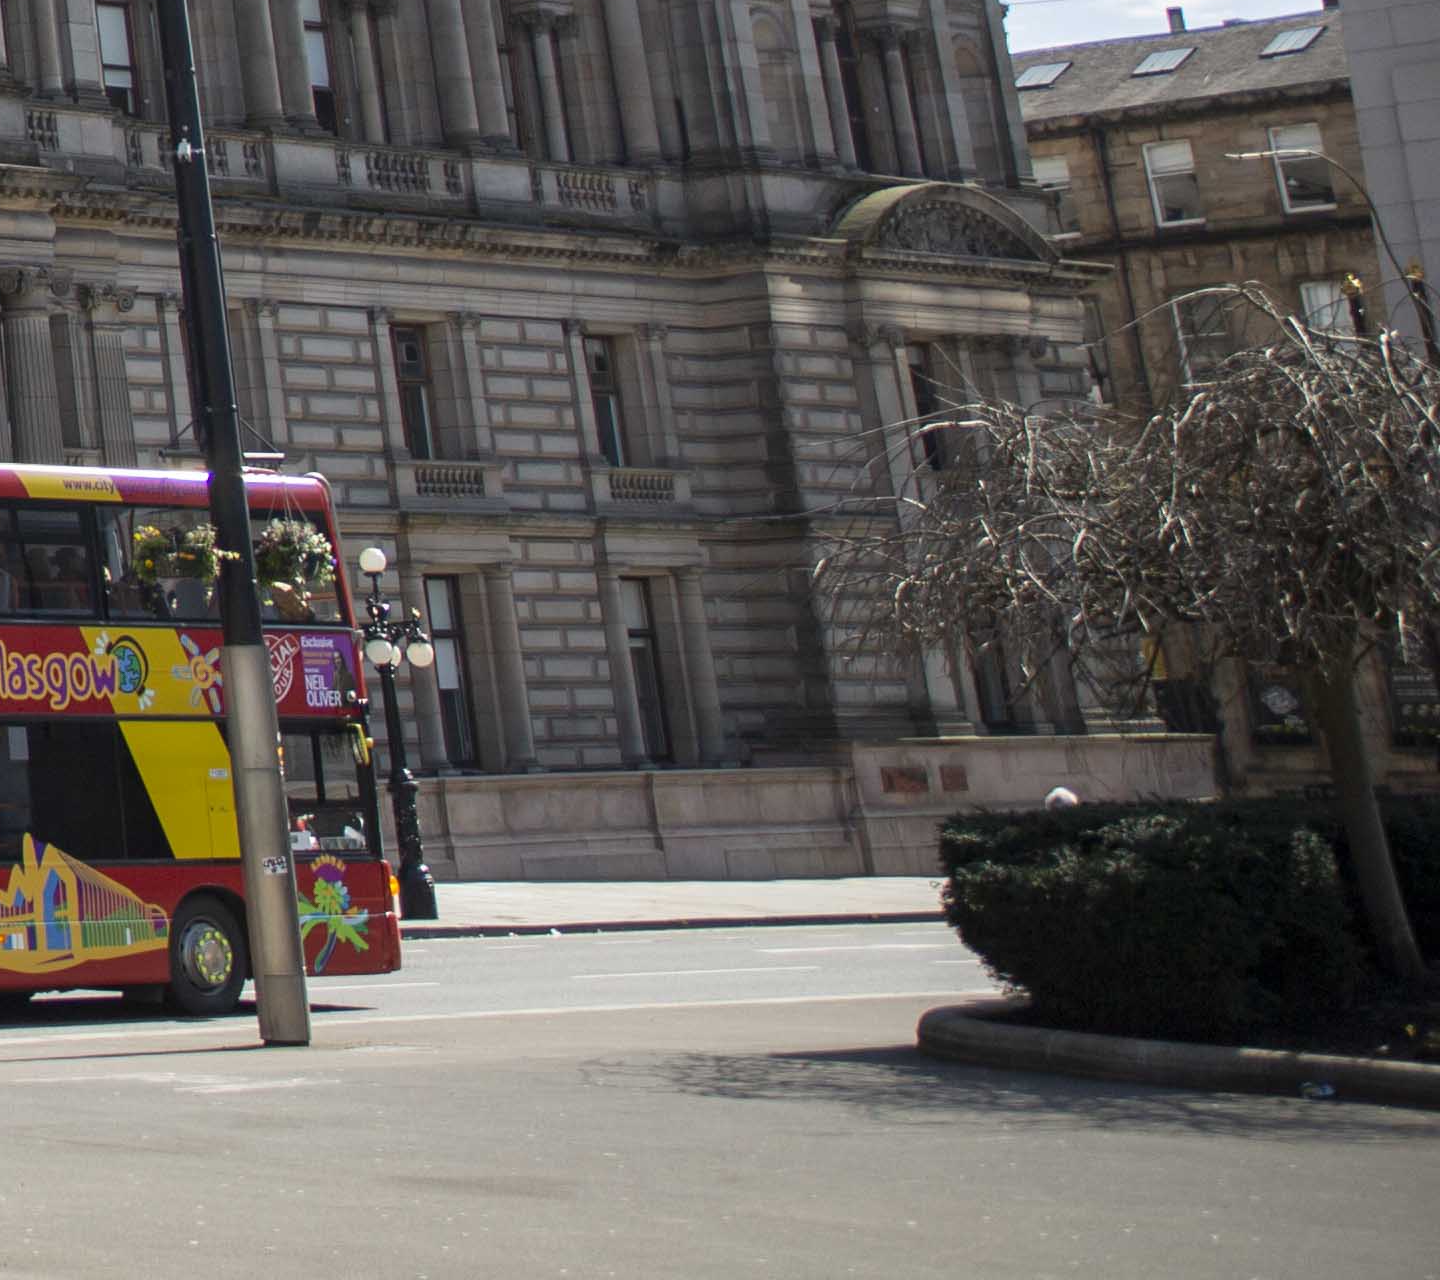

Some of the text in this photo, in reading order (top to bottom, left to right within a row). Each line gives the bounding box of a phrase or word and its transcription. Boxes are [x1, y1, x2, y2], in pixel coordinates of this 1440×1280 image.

[300, 636, 334, 648] Exclusive
[271, 639, 296, 672] CIAL
[305, 675, 328, 690] NEIL
[307, 690, 342, 707] OLIVER
